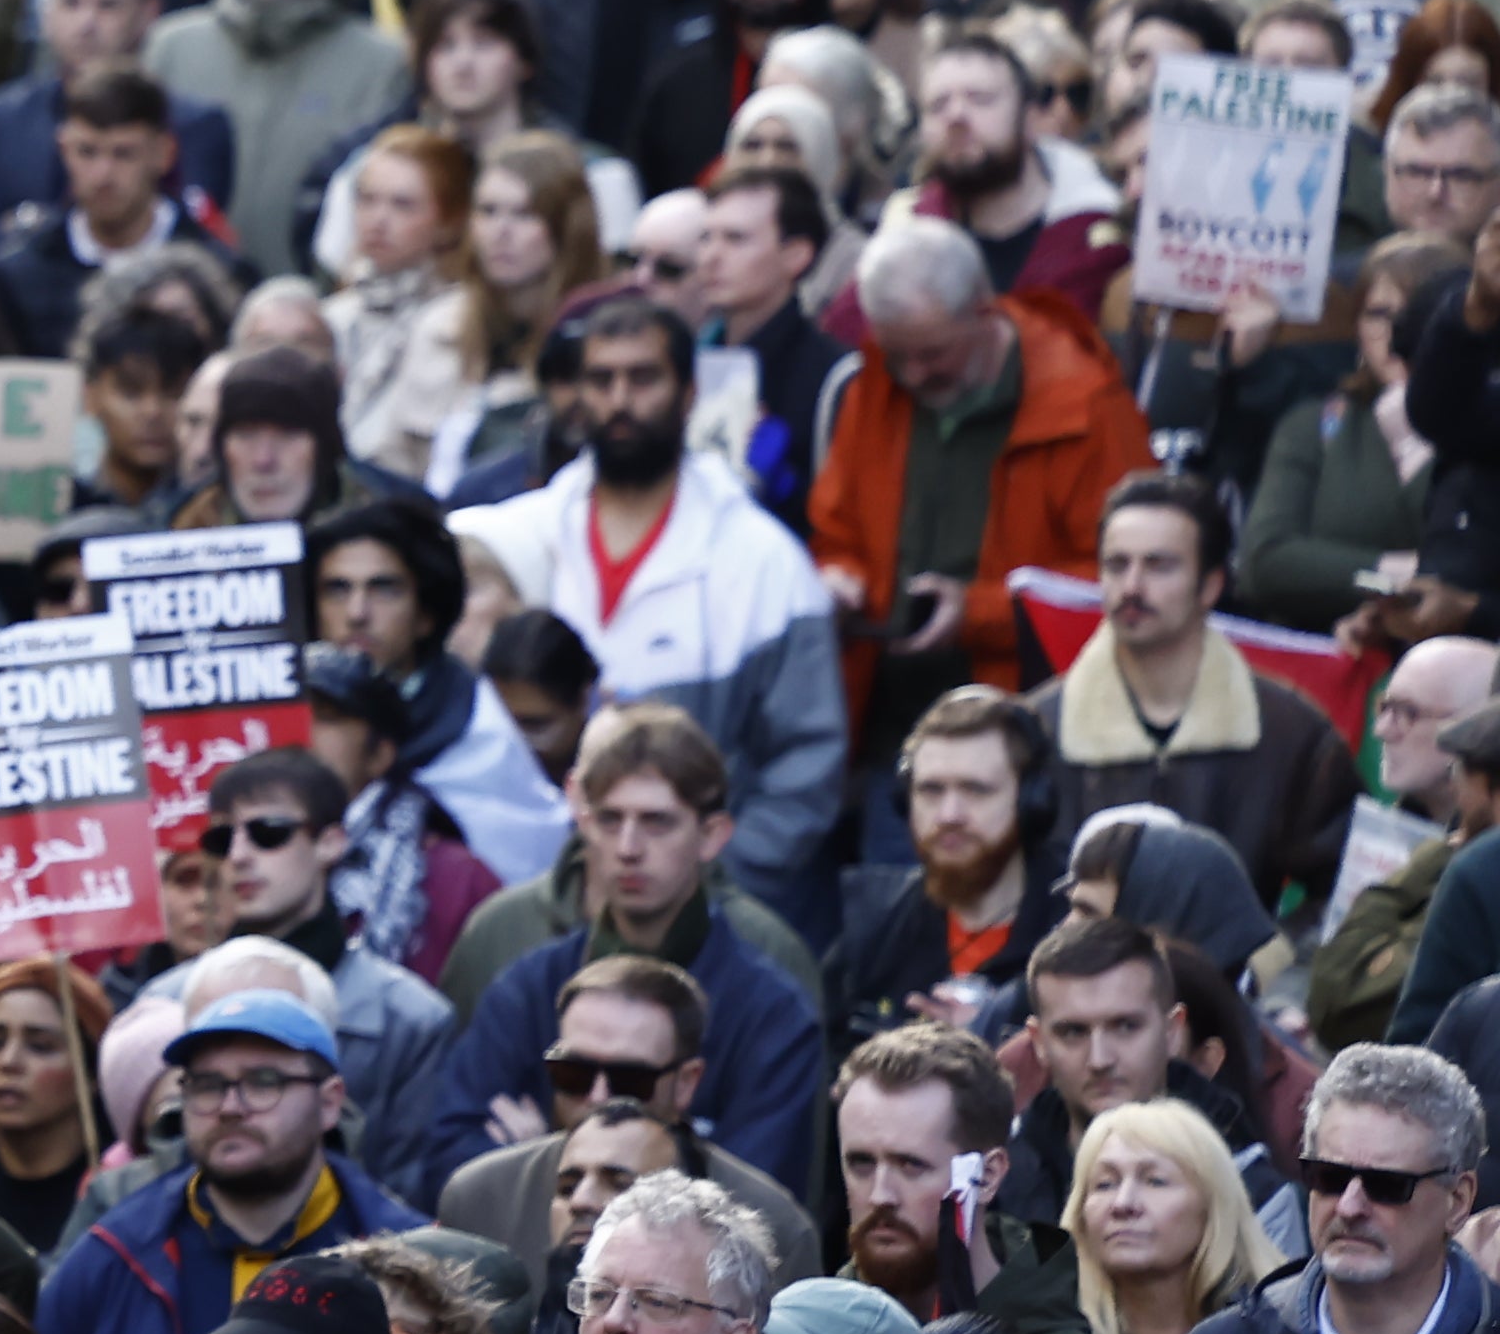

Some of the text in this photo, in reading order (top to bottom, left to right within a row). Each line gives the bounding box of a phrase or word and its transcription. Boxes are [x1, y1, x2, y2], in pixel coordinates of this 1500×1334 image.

[1160, 88, 1340, 135] PALESTINE
[107, 567, 284, 639] FREEDOM
[132, 643, 298, 713] ALESTINE
